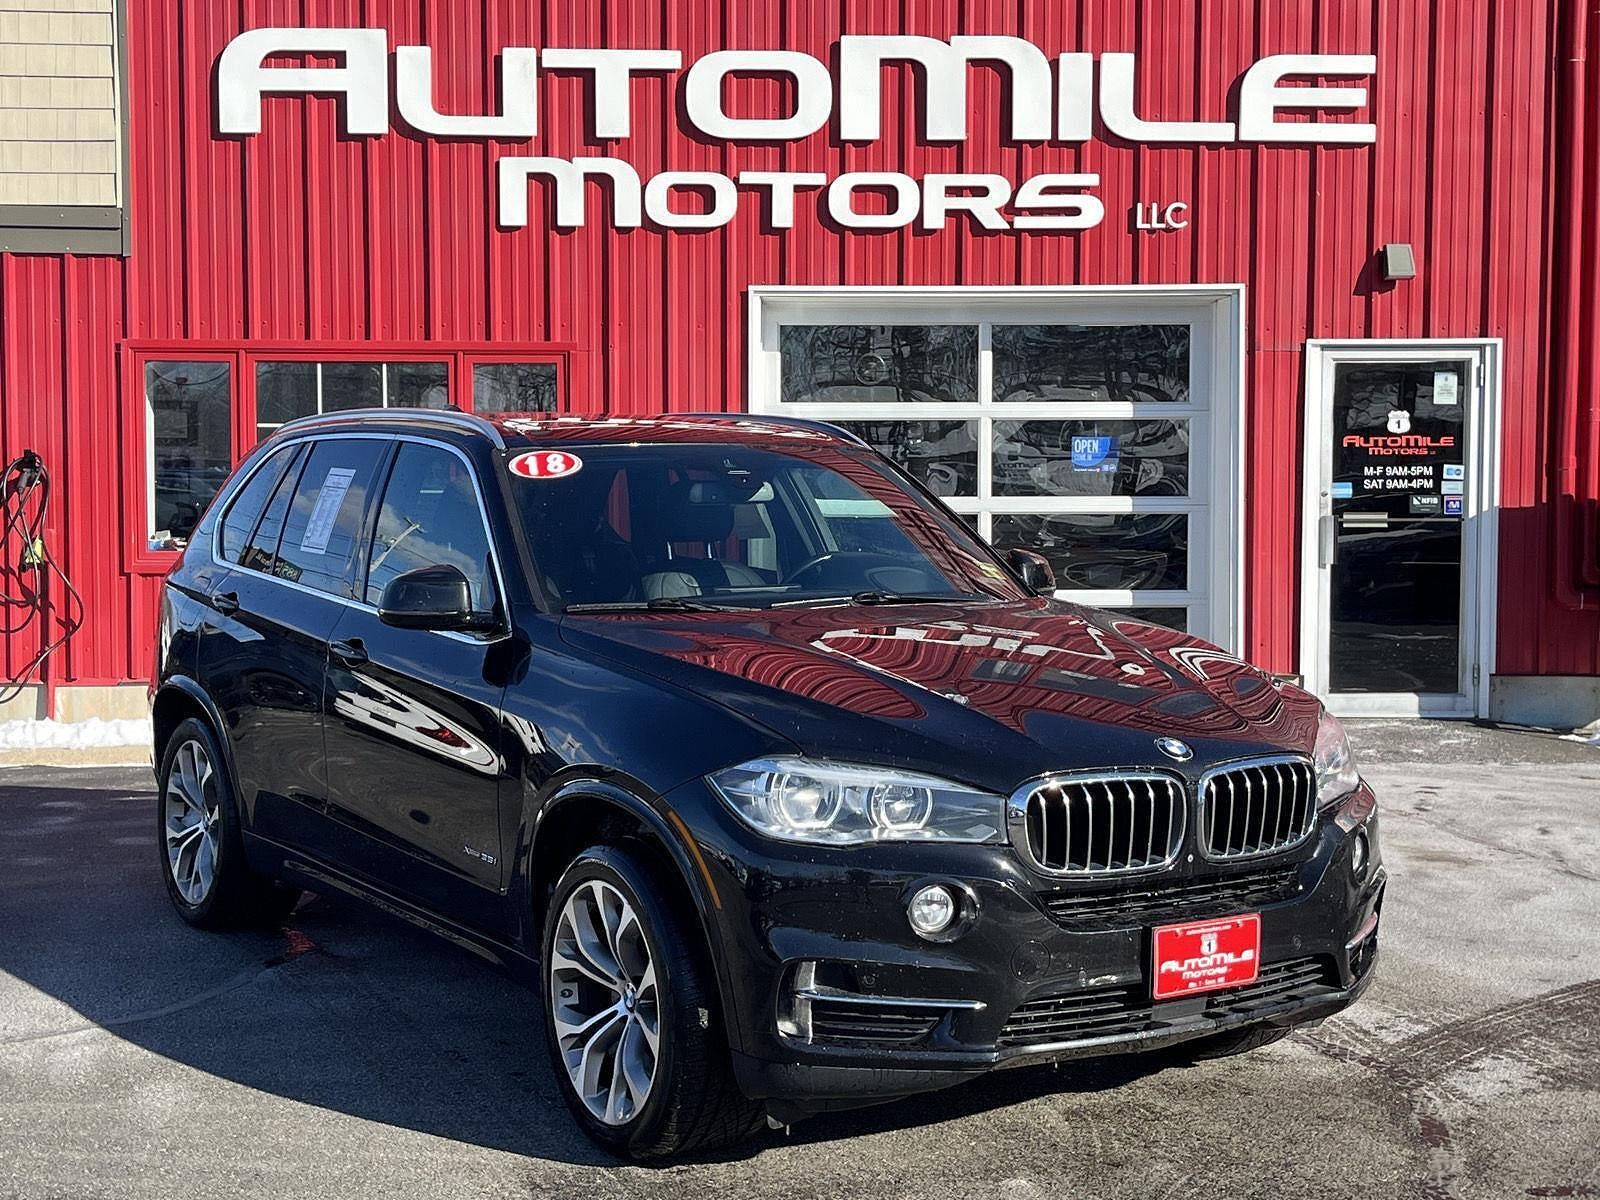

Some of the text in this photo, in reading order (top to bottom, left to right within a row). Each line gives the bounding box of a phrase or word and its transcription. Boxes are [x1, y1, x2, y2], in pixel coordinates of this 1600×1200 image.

[218, 28, 1377, 143] AUTOMILE
[499, 157, 1189, 230] MOTORS LLC
[1074, 439, 1099, 453] OPEN
[1342, 435, 1455, 447] AUTOMILE
[1368, 447, 1429, 455] MOTORS
[1364, 466, 1433, 476] M-F 9AM-5PM
[1364, 479, 1433, 489] SAT 9AM-4PM
[1161, 949, 1254, 974] AUTOMILE
